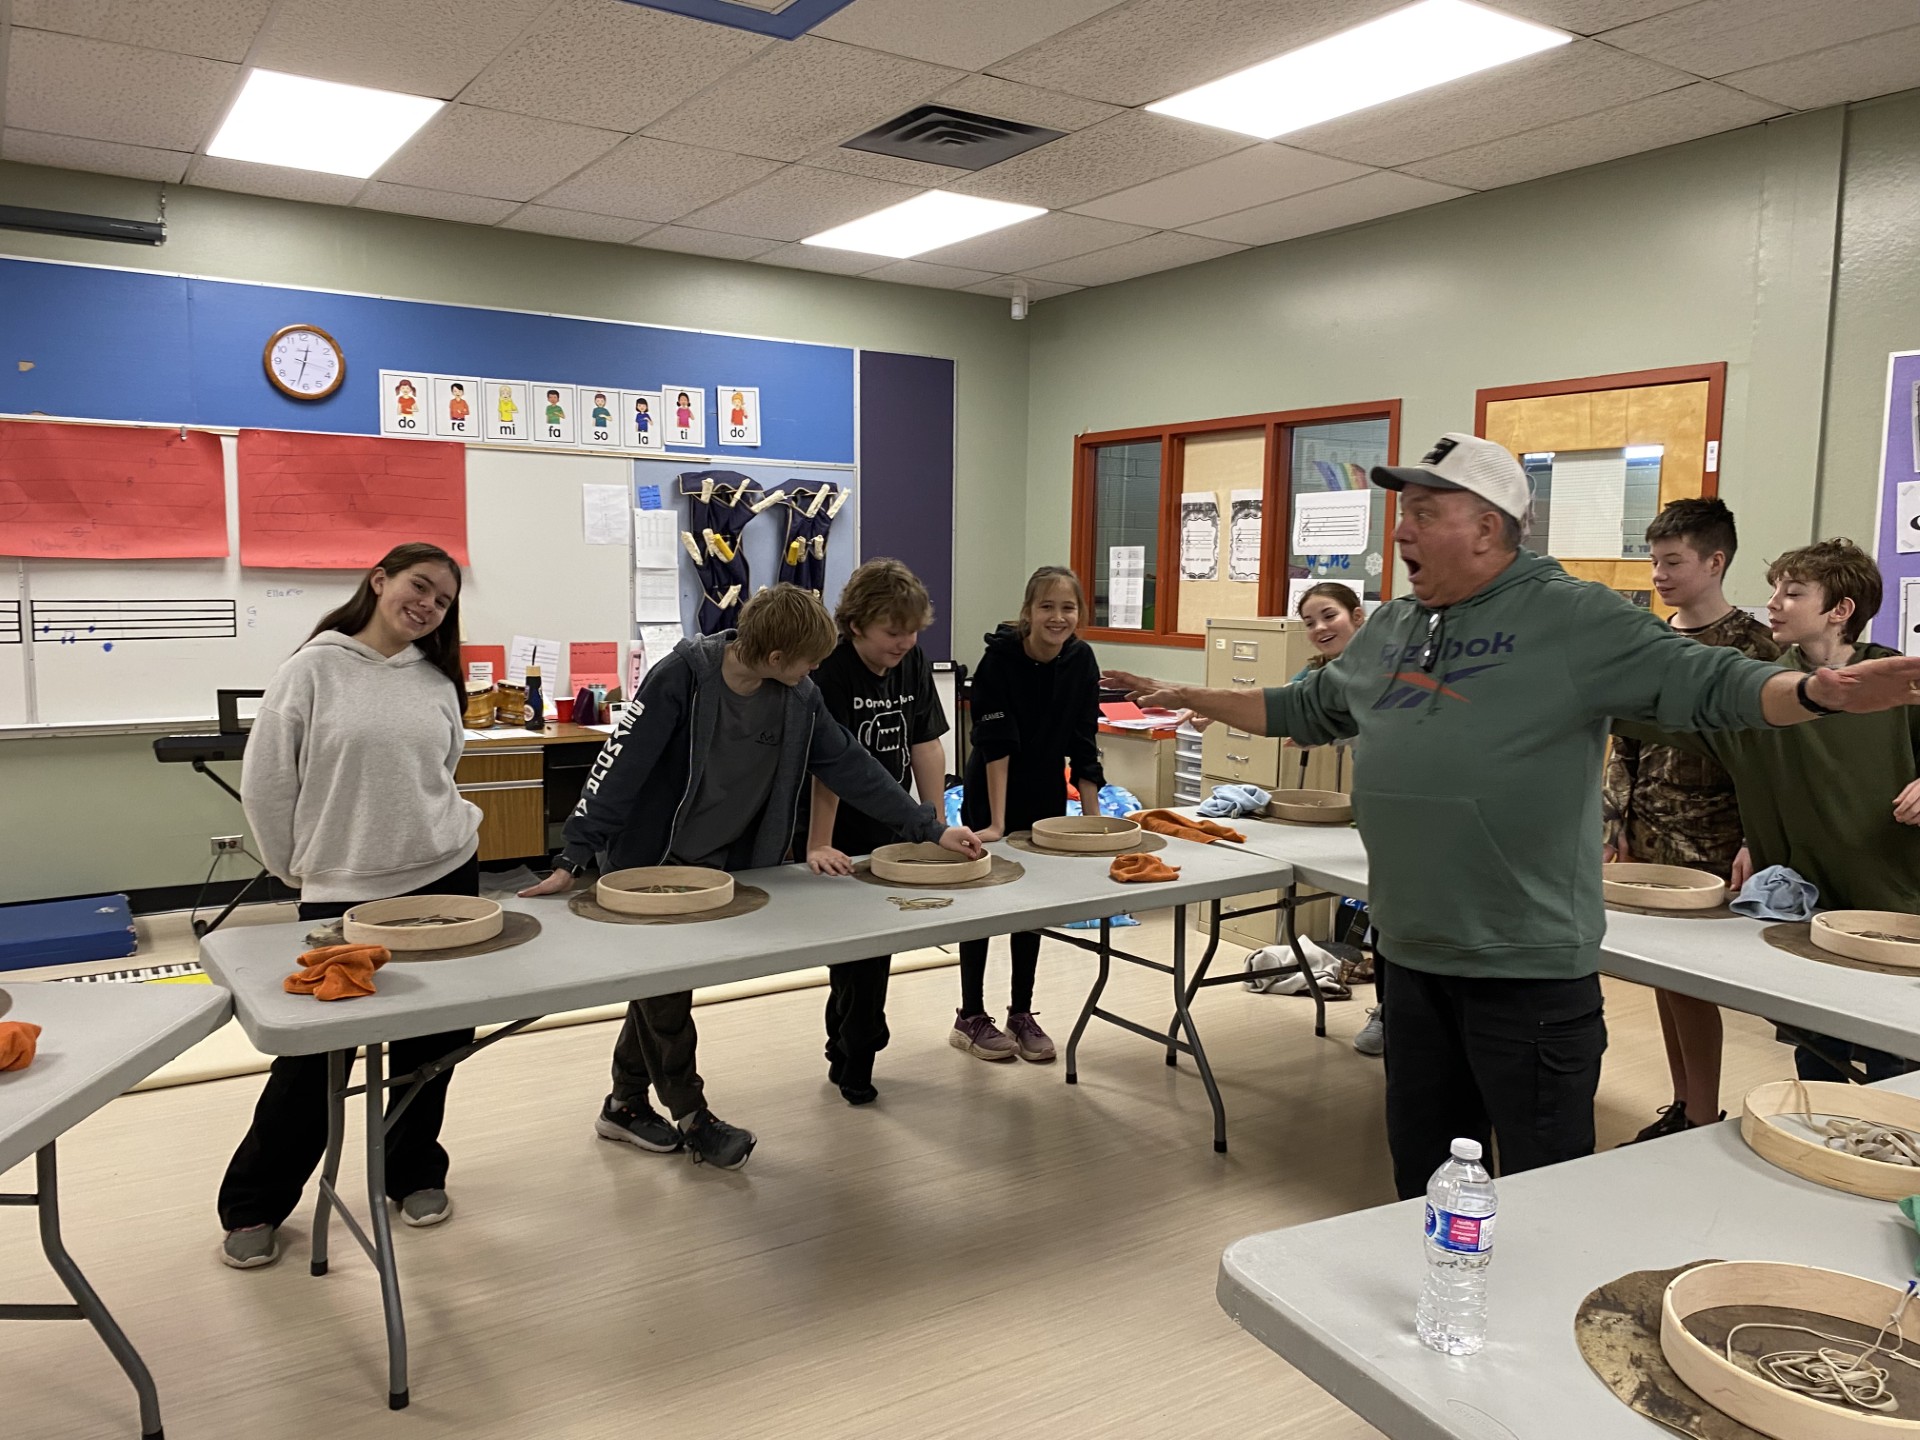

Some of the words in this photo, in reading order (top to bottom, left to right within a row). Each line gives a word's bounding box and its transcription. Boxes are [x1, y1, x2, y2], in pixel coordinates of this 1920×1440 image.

[287, 336, 295, 345] 11
[298, 333, 308, 342] 12
[315, 338, 319, 346] 1
[277, 345, 288, 354] 10
[322, 347, 331, 356] 2
[274, 357, 282, 365] 9
[327, 360, 335, 368] 3
[279, 369, 287, 378] 8
[302, 383, 310, 391] 6
[398, 416, 416, 430] do
[451, 420, 465, 432] re
[499, 423, 516, 436] mi
[548, 424, 561, 439] fa
[679, 428, 688, 441] ti
[594, 430, 608, 441] so
[637, 432, 649, 445] la
[586, 699, 646, 796] SEYMOUR
[574, 798, 588, 817] A
